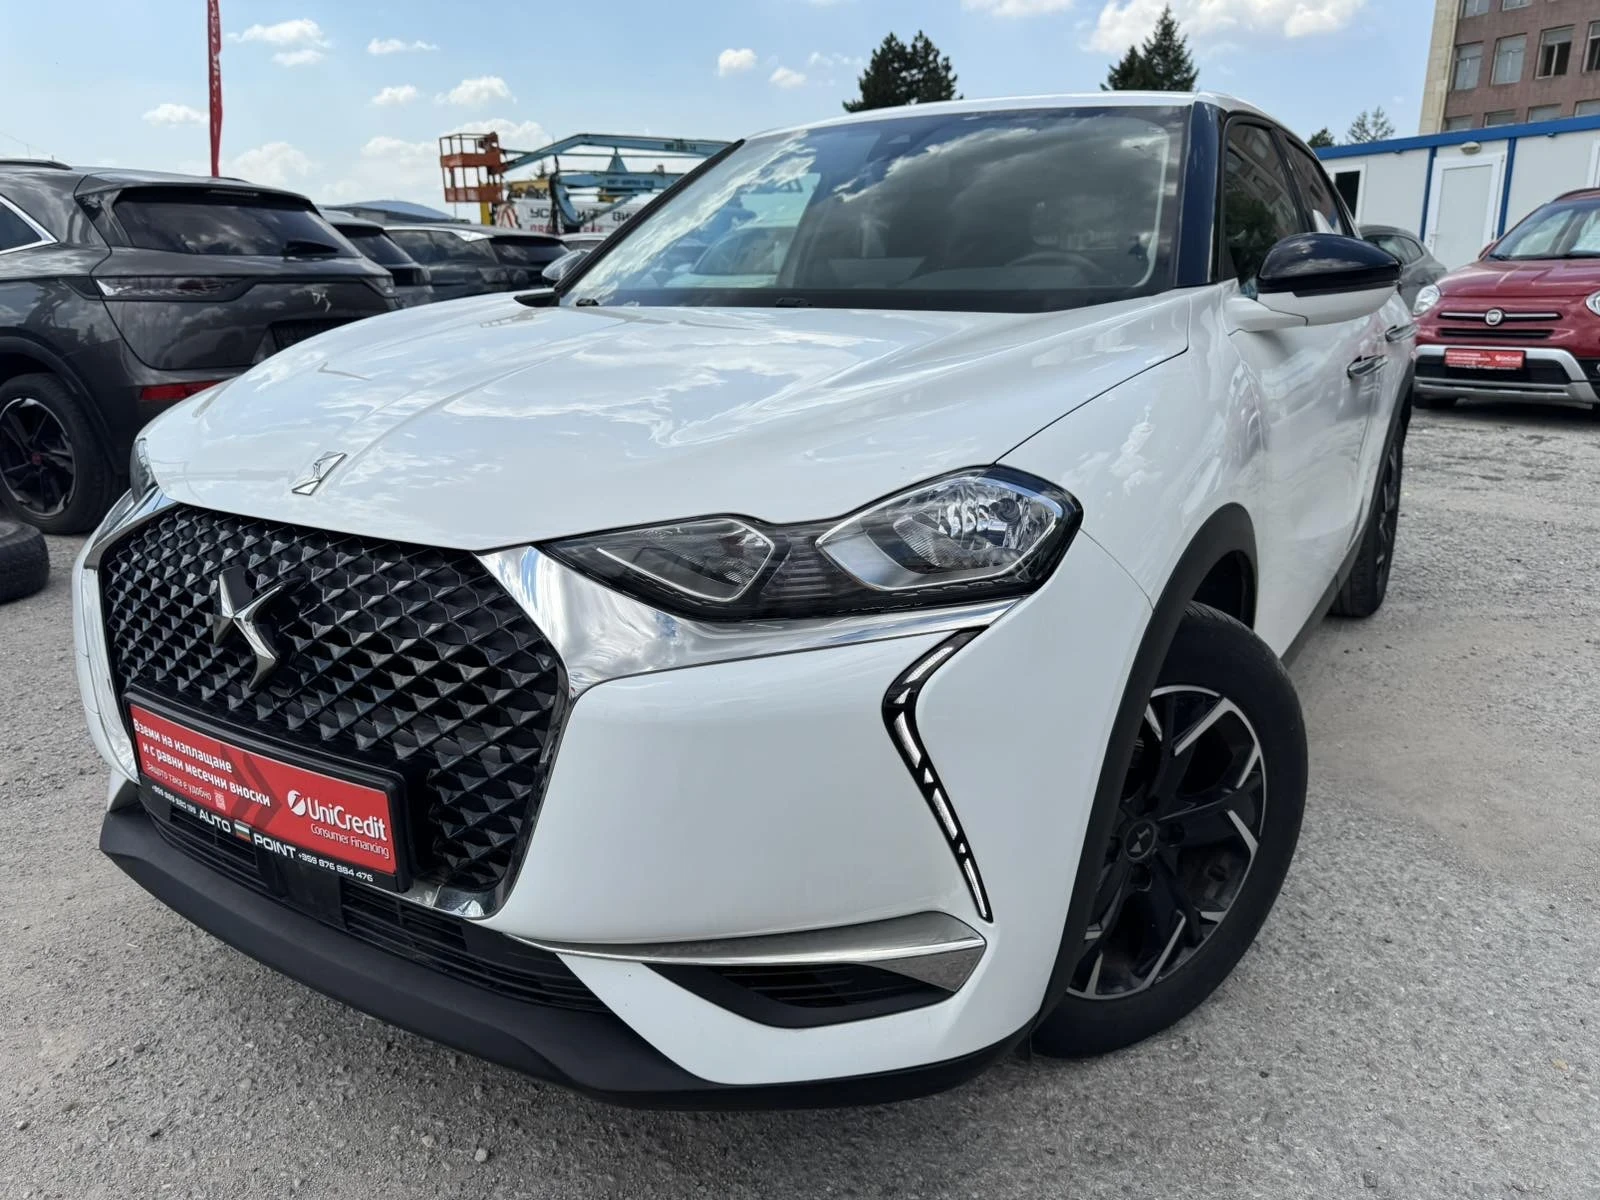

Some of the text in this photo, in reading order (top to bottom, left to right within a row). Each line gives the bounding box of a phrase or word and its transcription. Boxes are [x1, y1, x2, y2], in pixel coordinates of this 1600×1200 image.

[133, 718, 233, 773] Вземи на изплащане
[142, 742, 149, 753] и
[156, 749, 184, 771] равни
[185, 763, 228, 790] месечни
[229, 782, 271, 807] вноски
[199, 808, 232, 833] AUTO
[253, 832, 296, 859] POINT
[355, 870, 374, 882] 476
[307, 797, 387, 841] UniCredit
[310, 823, 390, 860] Consumer Financing
